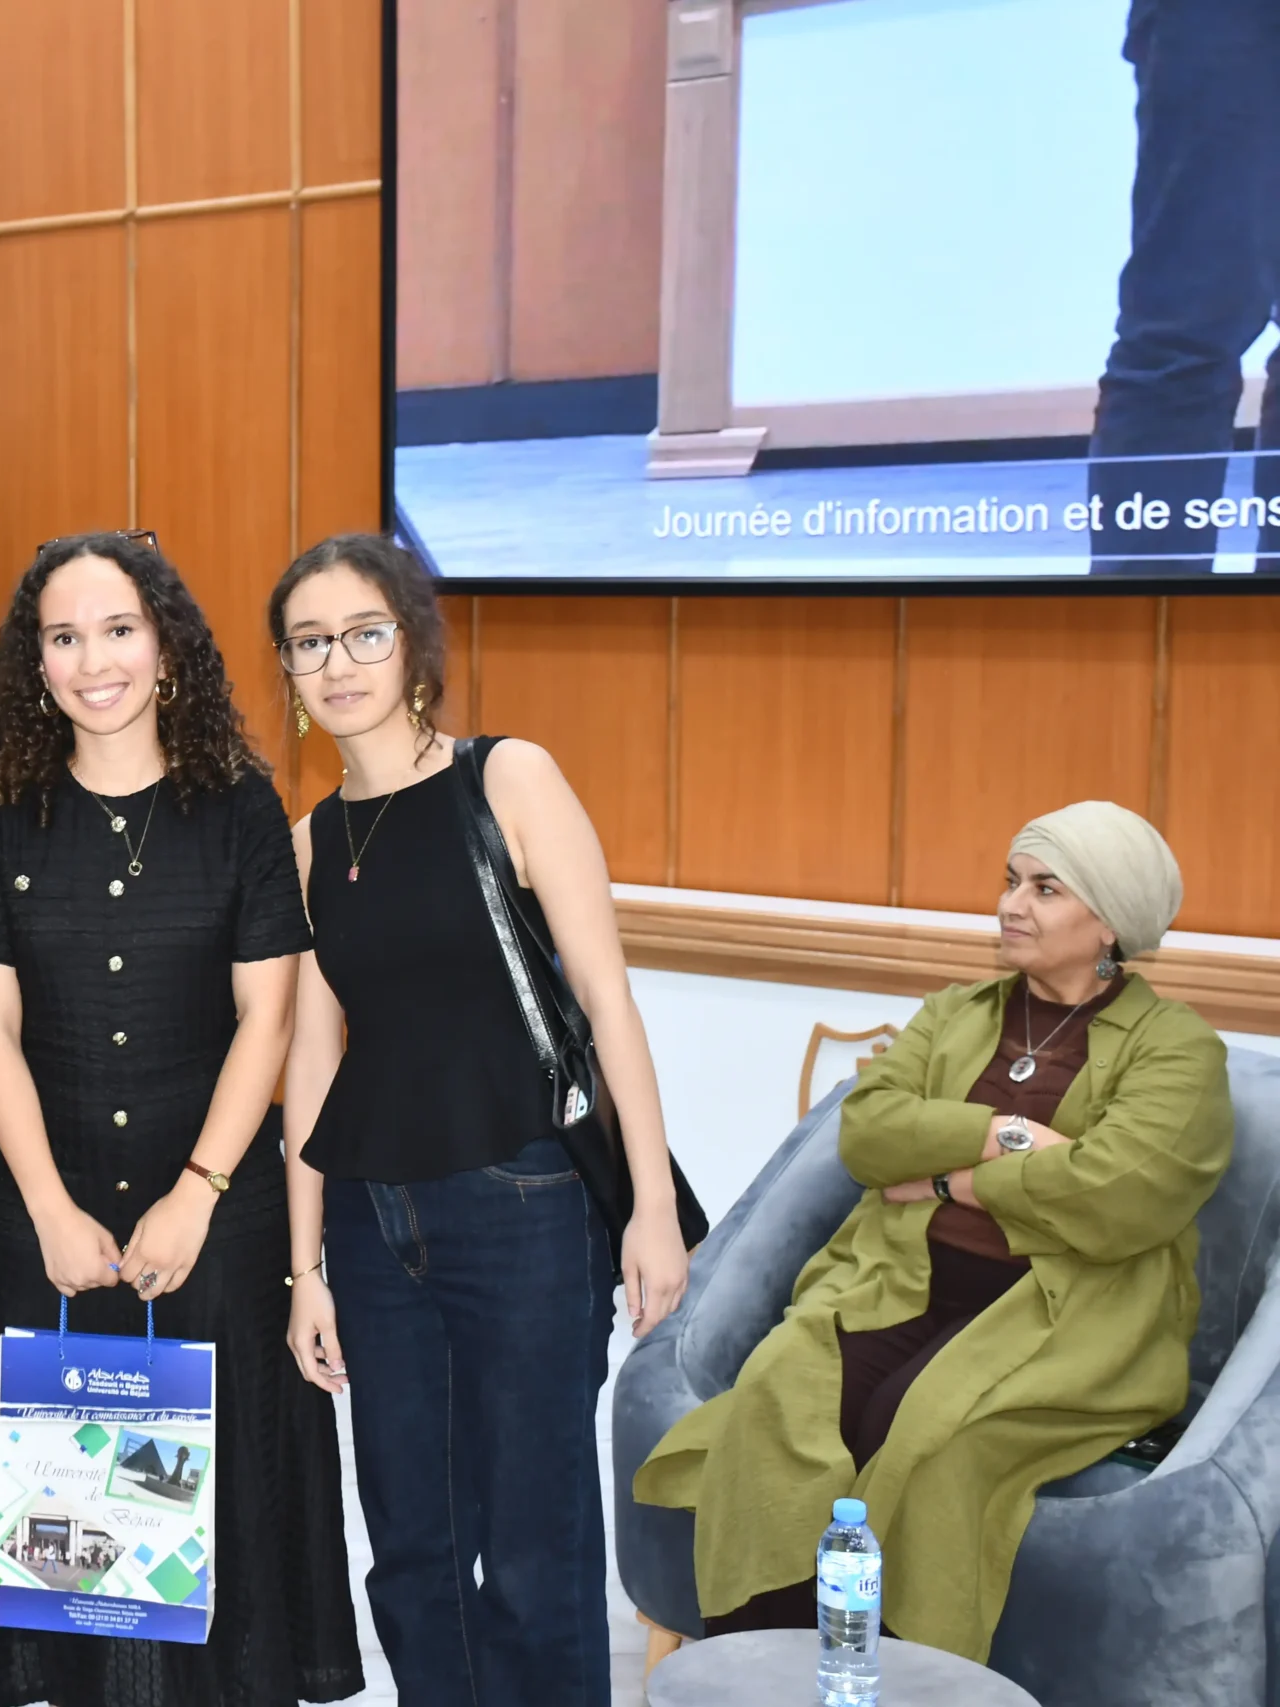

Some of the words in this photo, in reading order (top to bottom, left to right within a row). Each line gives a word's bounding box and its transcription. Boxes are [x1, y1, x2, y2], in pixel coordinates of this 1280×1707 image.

[653, 502, 793, 538] Journée
[803, 498, 1049, 536] d'information
[1063, 494, 1104, 532] et
[1115, 491, 1171, 530] de
